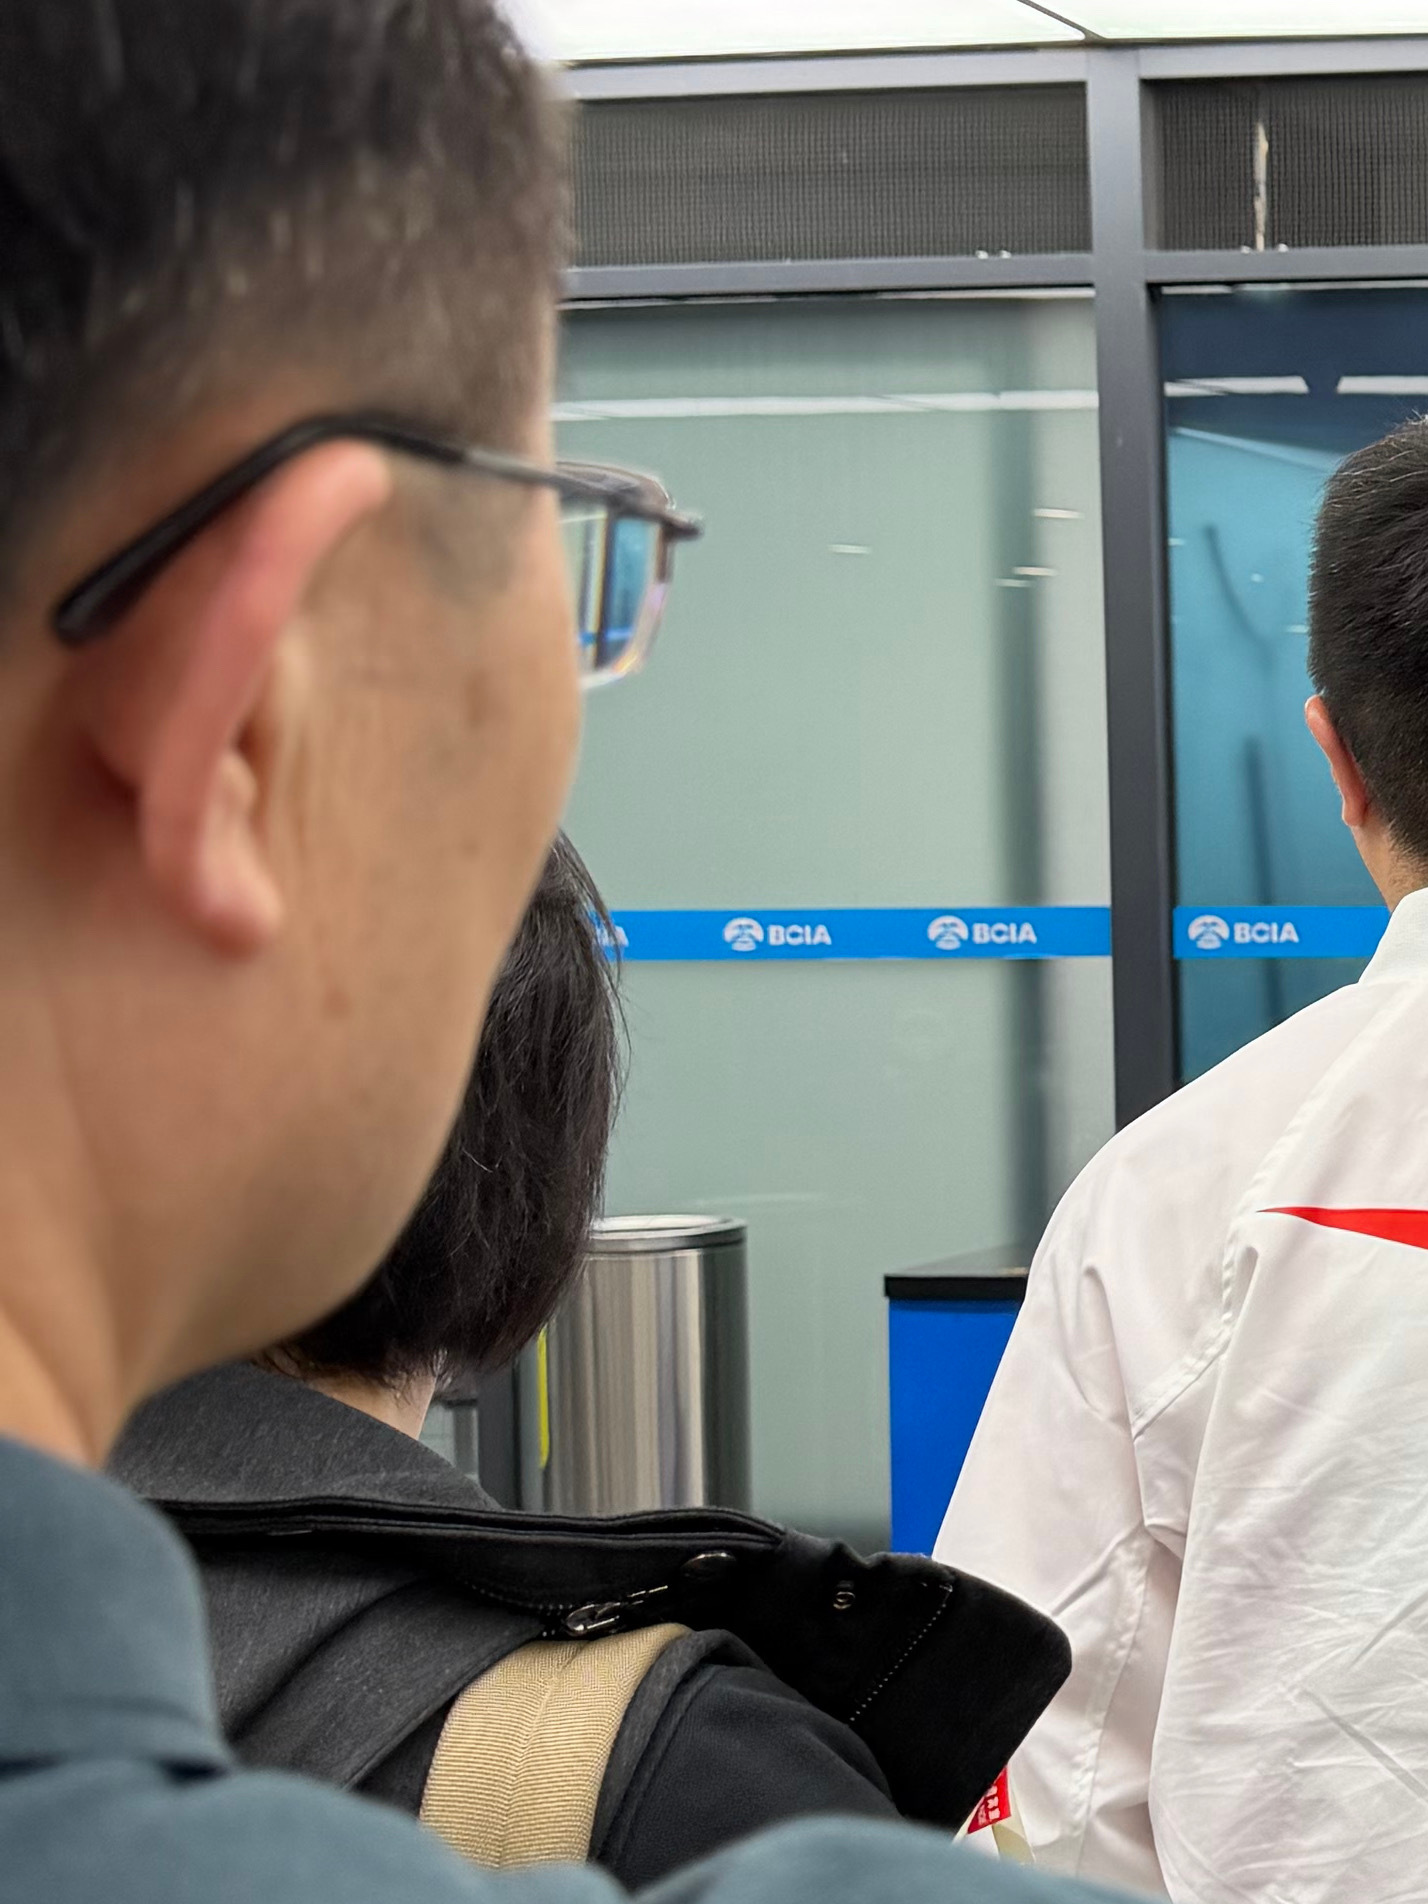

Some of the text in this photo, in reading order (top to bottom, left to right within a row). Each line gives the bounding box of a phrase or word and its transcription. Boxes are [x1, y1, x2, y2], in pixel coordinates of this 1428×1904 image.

[767, 925, 832, 947] BCIA
[972, 923, 1038, 945] BCIA
[1234, 921, 1300, 945] BCIA
